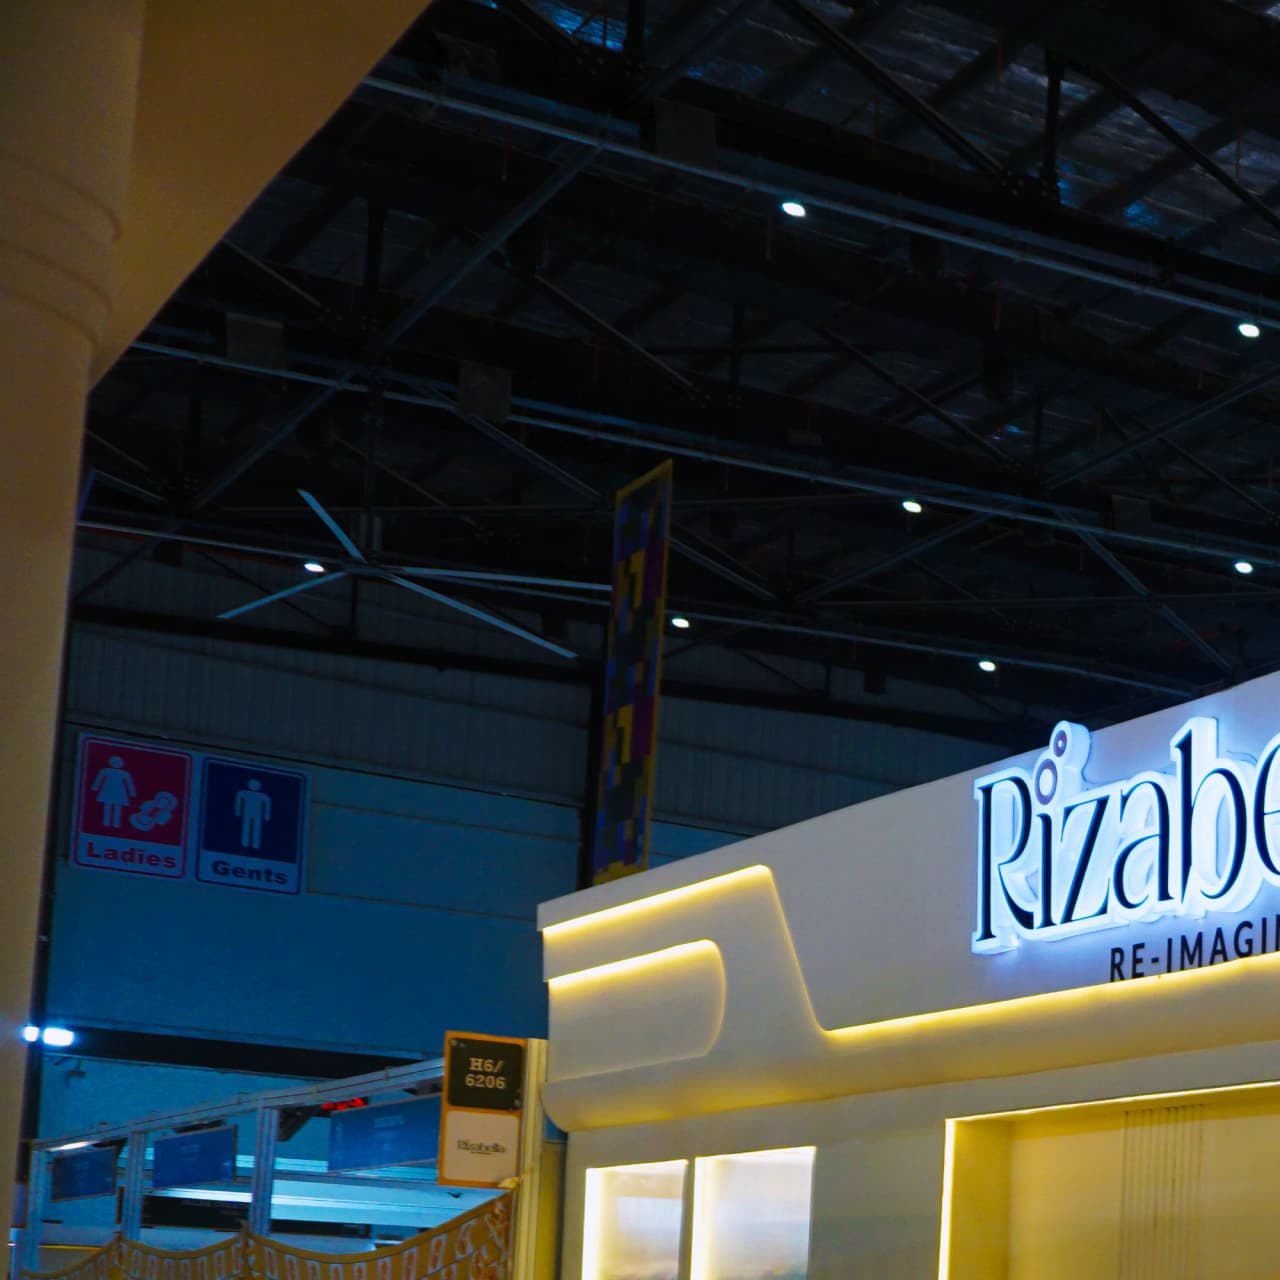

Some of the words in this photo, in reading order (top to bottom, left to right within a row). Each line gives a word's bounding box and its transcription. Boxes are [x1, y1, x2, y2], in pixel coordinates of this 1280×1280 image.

[86, 842, 177, 869] Ladies
[211, 860, 289, 885] Gents
[464, 1073, 507, 1090] 6206
